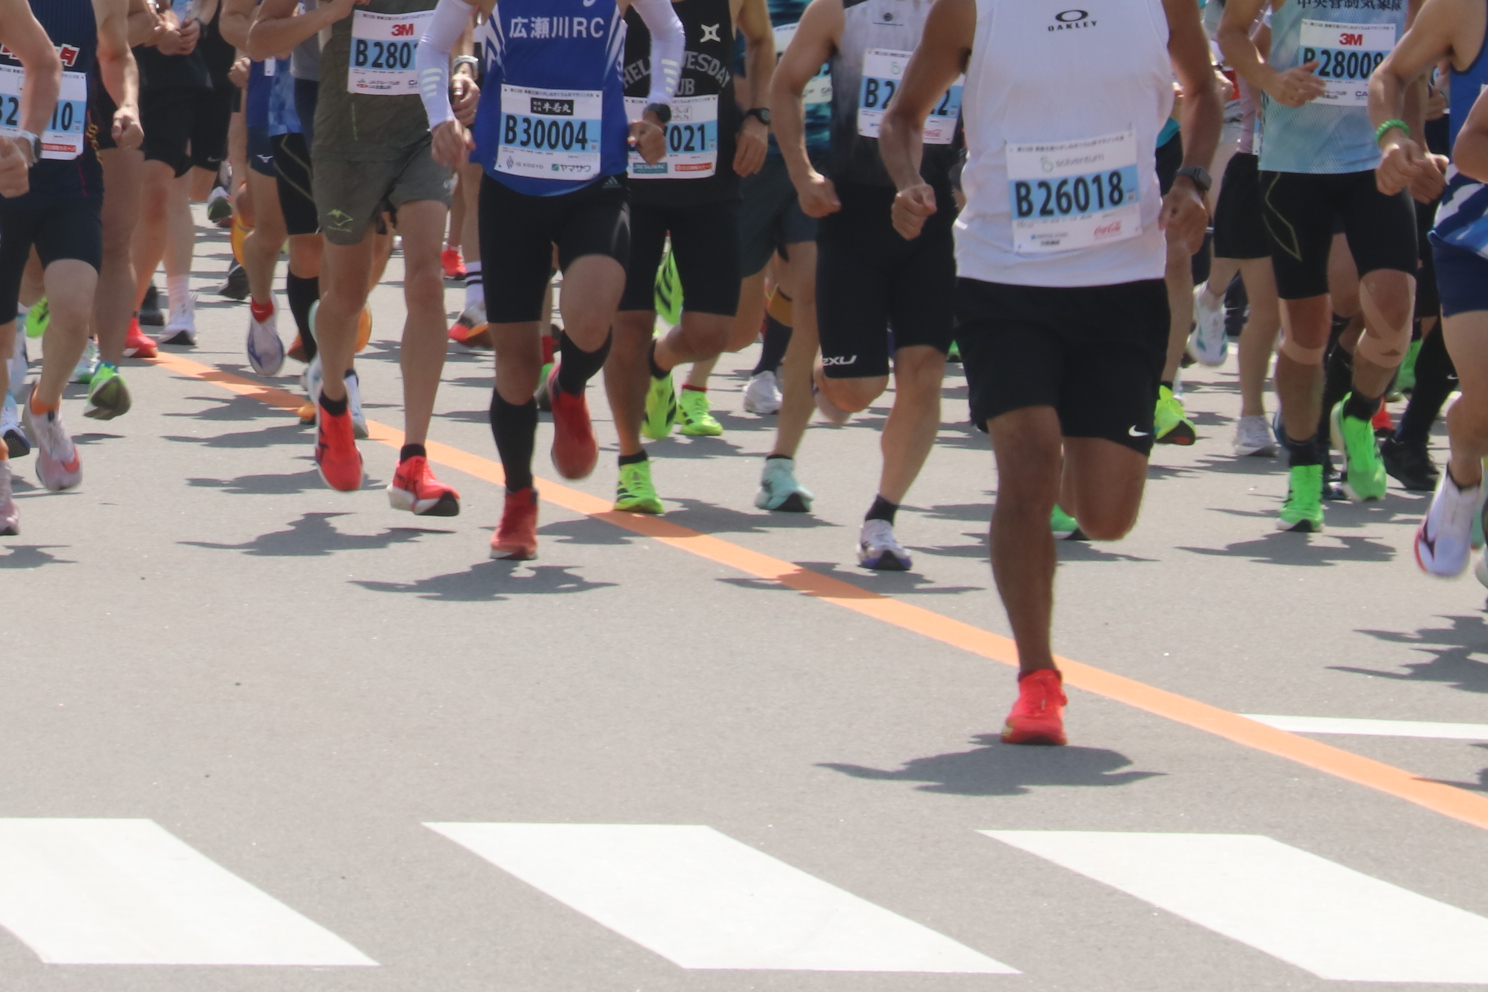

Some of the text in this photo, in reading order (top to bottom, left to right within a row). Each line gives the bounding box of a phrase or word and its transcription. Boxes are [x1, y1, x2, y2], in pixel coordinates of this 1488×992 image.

[391, 23, 415, 36] 3M
[509, 16, 604, 39] 広瀬川RC
[1048, 20, 1098, 32] OAKLEY
[1339, 33, 1363, 46] 3M
[355, 39, 419, 68] B280
[623, 58, 651, 89] HEL
[675, 78, 696, 95] UB
[865, 78, 950, 116] B22
[504, 115, 588, 151] B30004
[663, 124, 706, 152] 021
[560, 164, 591, 172] ヤマサワ
[1015, 171, 1124, 218] B26018
[822, 355, 857, 366] 2XU
